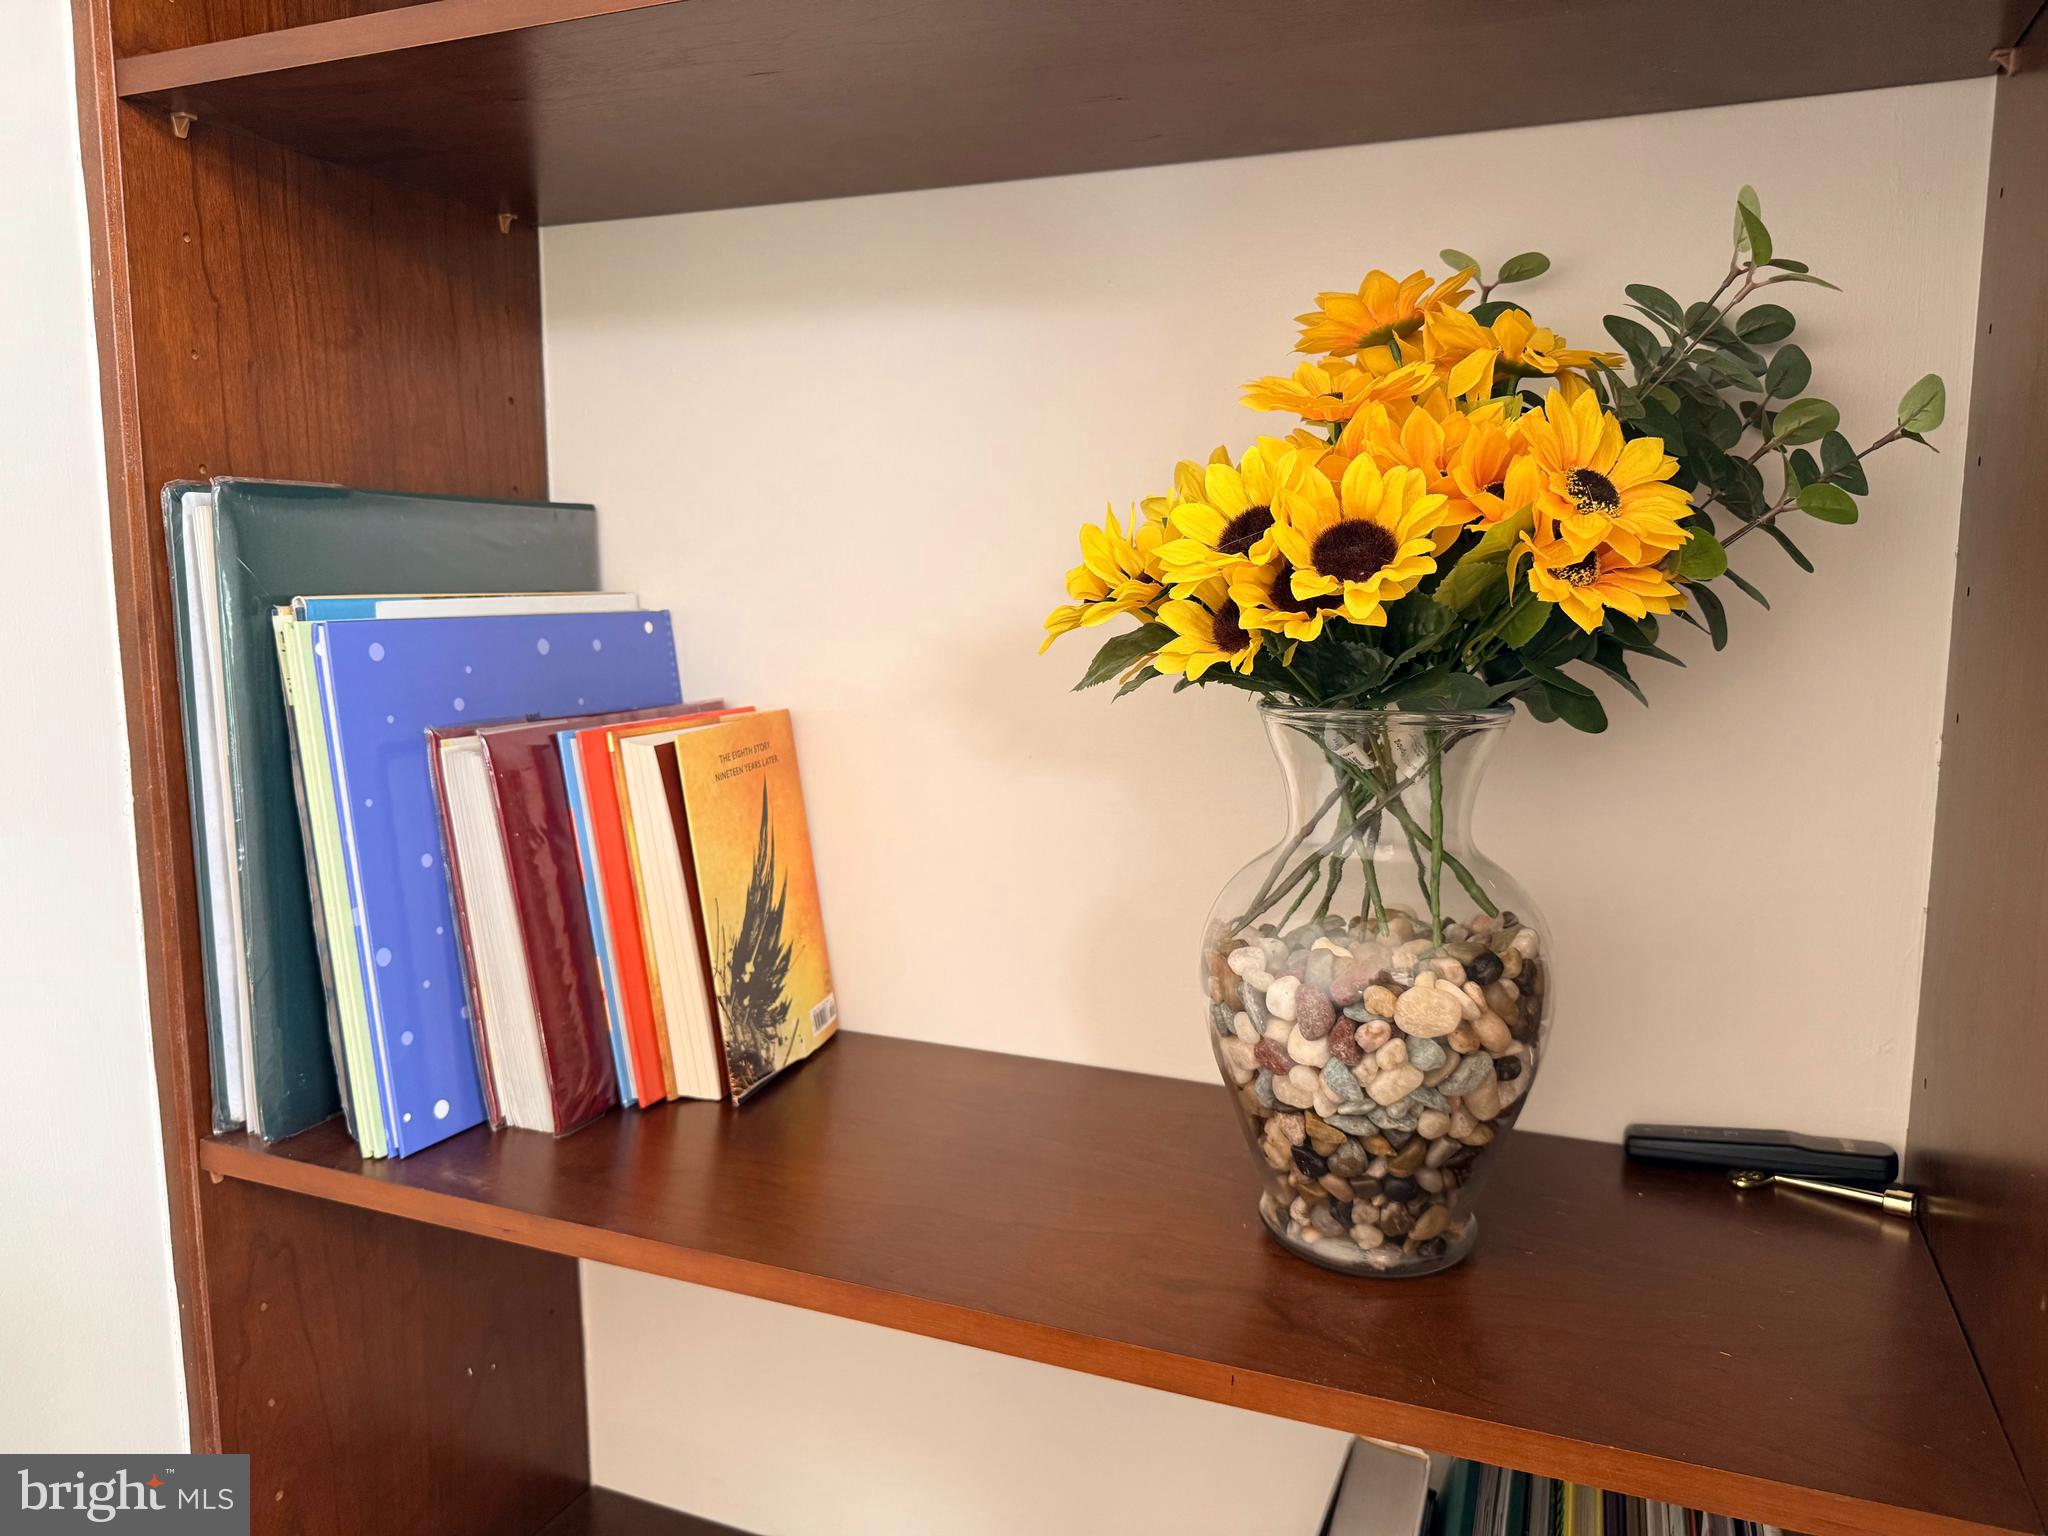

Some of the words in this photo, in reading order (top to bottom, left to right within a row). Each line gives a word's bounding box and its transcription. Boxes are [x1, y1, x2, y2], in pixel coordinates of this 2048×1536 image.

[718, 752, 731, 764] THE
[732, 746, 753, 760] EIGHTH
[714, 766, 744, 781] NINETEEN
[744, 760, 761, 772] YEARS
